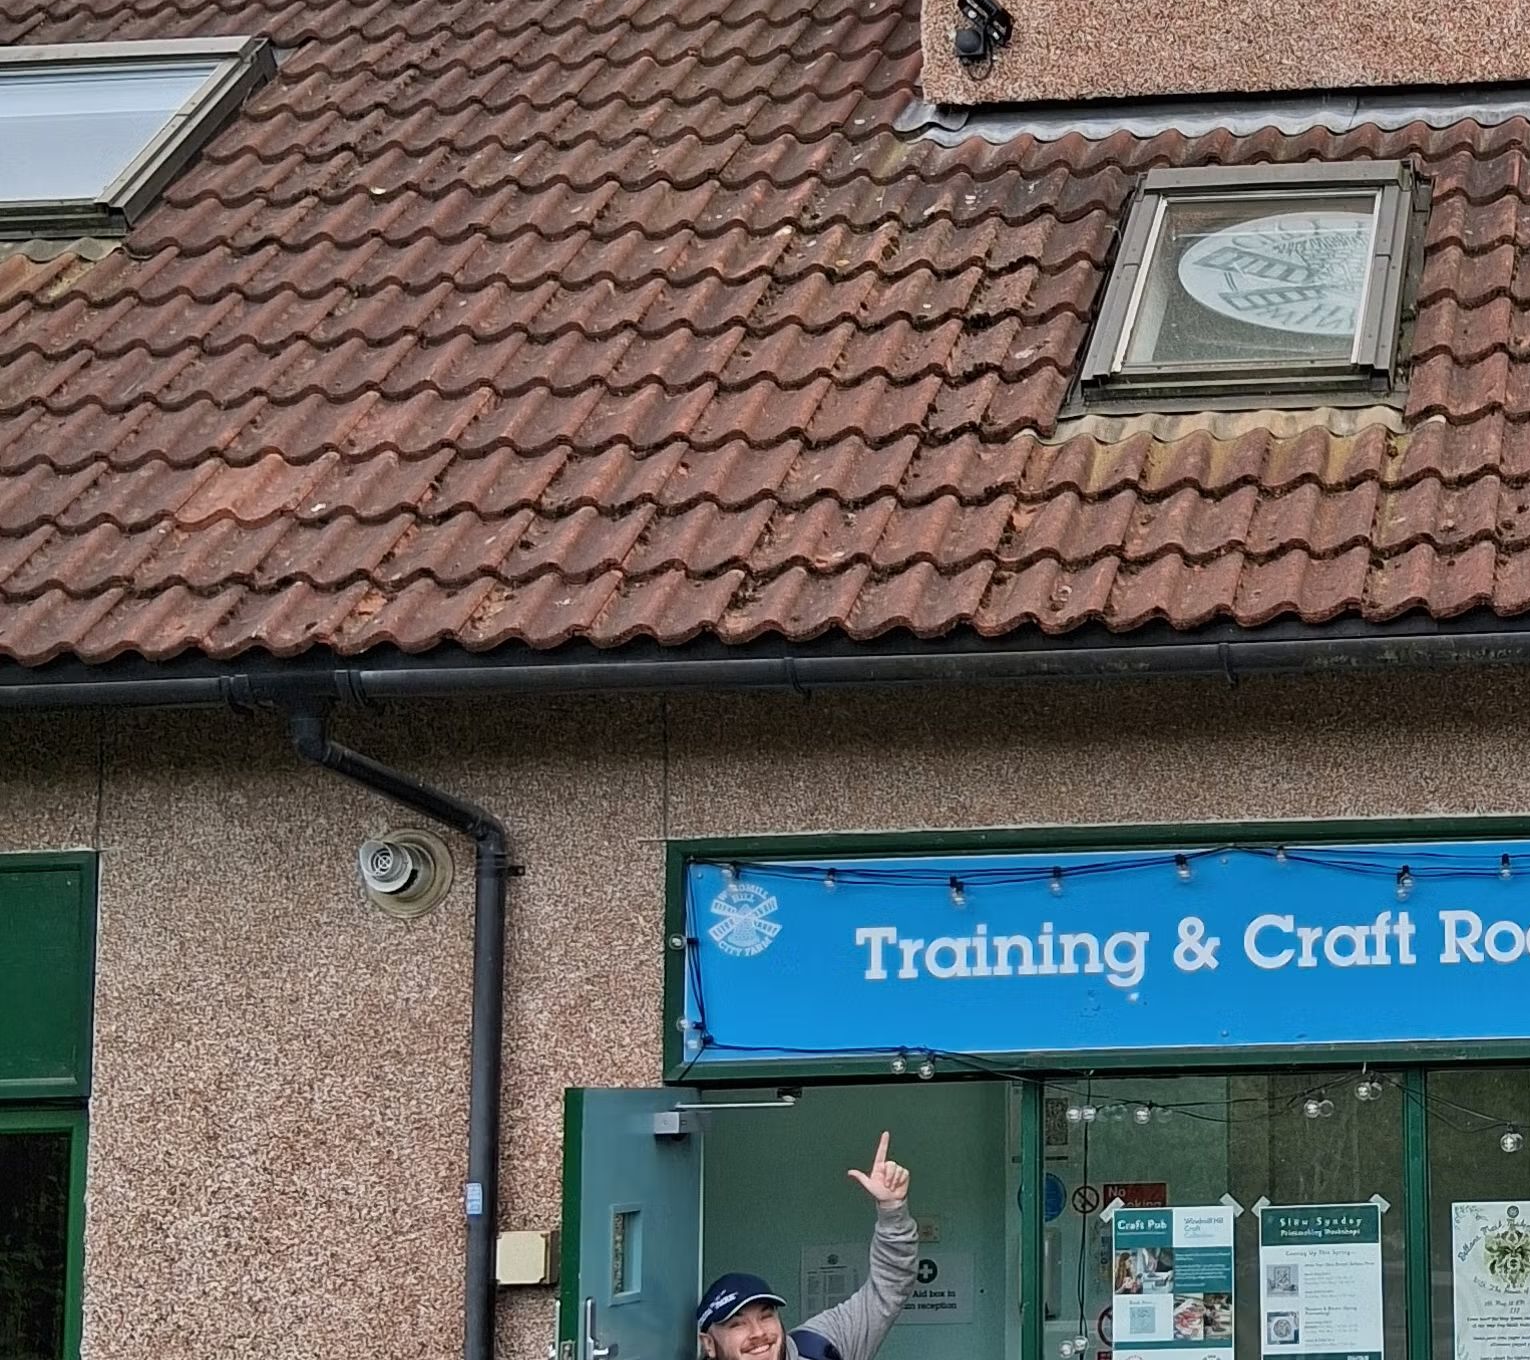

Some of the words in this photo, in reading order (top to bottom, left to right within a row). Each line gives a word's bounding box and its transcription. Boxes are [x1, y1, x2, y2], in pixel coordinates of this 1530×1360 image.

[855, 923, 1150, 987] Training
[1173, 916, 1221, 971] &
[1243, 911, 1417, 969] Craft
[1108, 1186, 1127, 1198] No
[1117, 1220, 1145, 1230] Craft
[1147, 1219, 1168, 1230] Pub
[911, 1289, 928, 1298] Aid
[929, 1289, 945, 1298] box
[947, 1289, 957, 1298] in
[917, 1301, 958, 1312] reception
